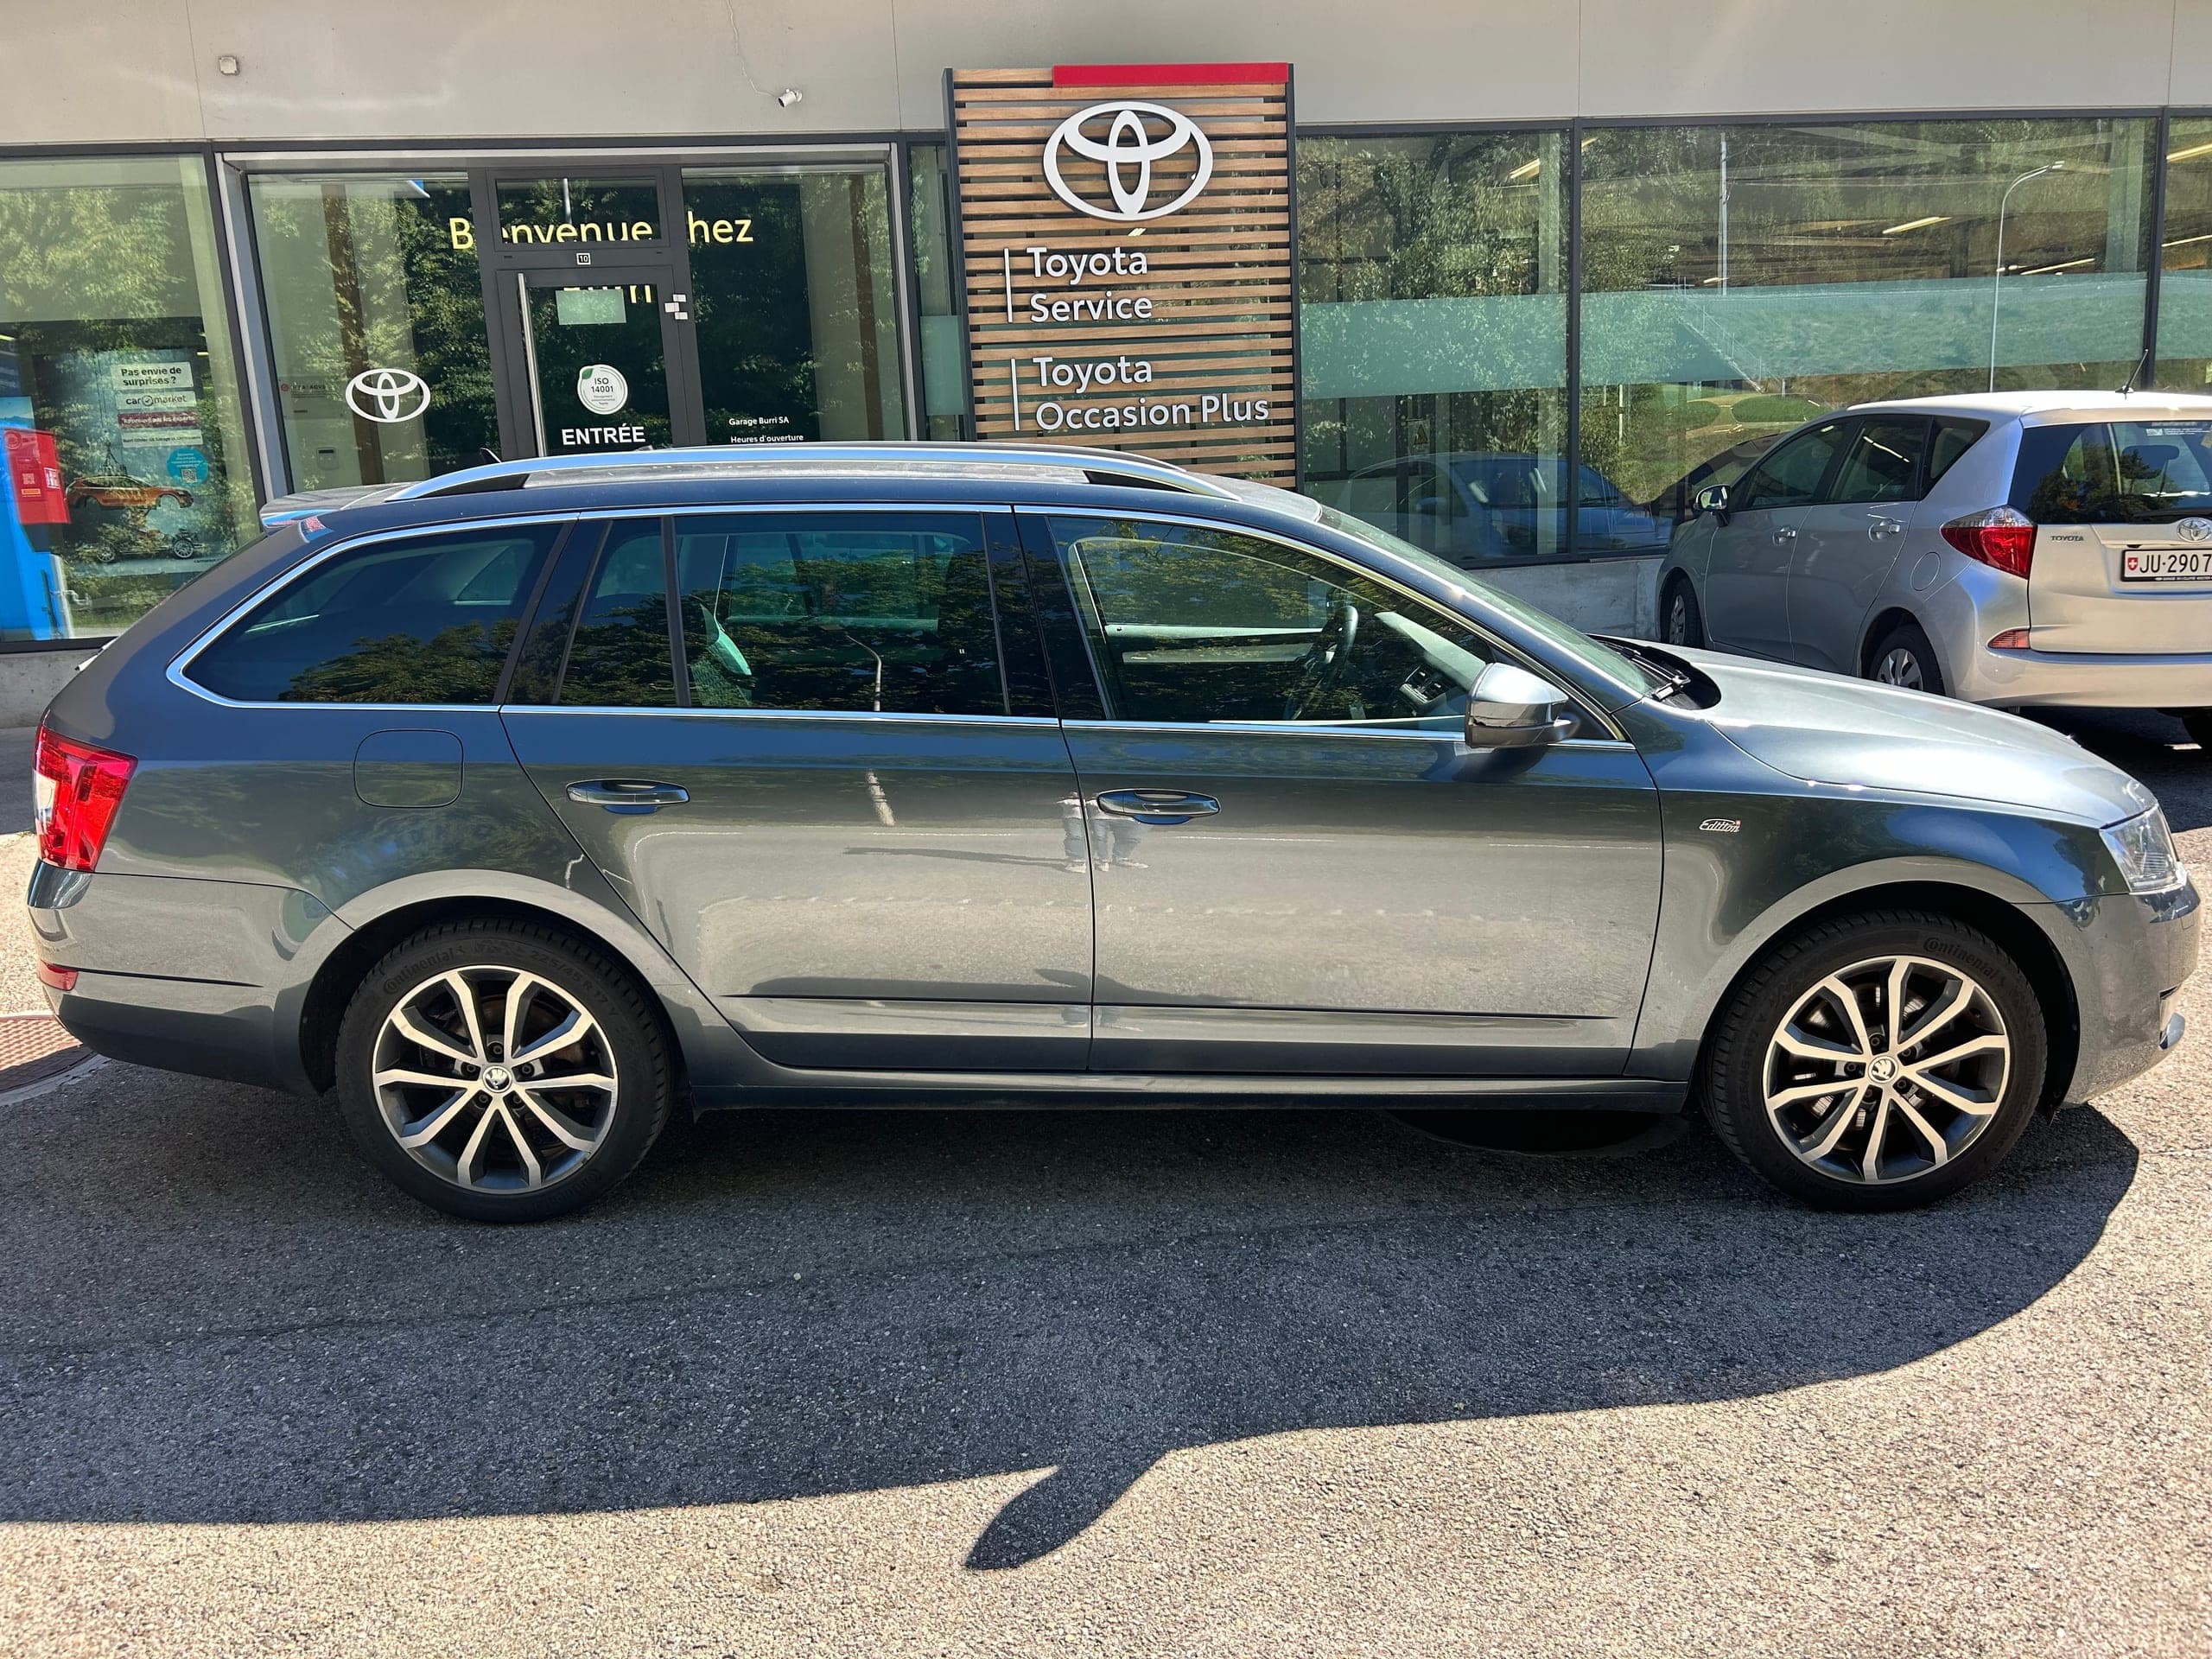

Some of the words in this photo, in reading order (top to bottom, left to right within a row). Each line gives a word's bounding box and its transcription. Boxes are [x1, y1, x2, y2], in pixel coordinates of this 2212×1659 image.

[449, 217, 653, 250] Bnvenue
[687, 211, 753, 243] hez
[1027, 246, 1147, 285] Toyota
[1030, 291, 1152, 322] Service
[123, 377, 169, 386] surprises
[142, 367, 167, 376] envie
[1033, 356, 1152, 393] Toyota
[1036, 397, 1191, 430] Occasion
[1201, 393, 1268, 423] Plus
[562, 423, 645, 445] ENTRÉE
[1699, 818, 1740, 833] Edition
[383, 948, 454, 995] Continental
[1923, 937, 1999, 980] Continental
